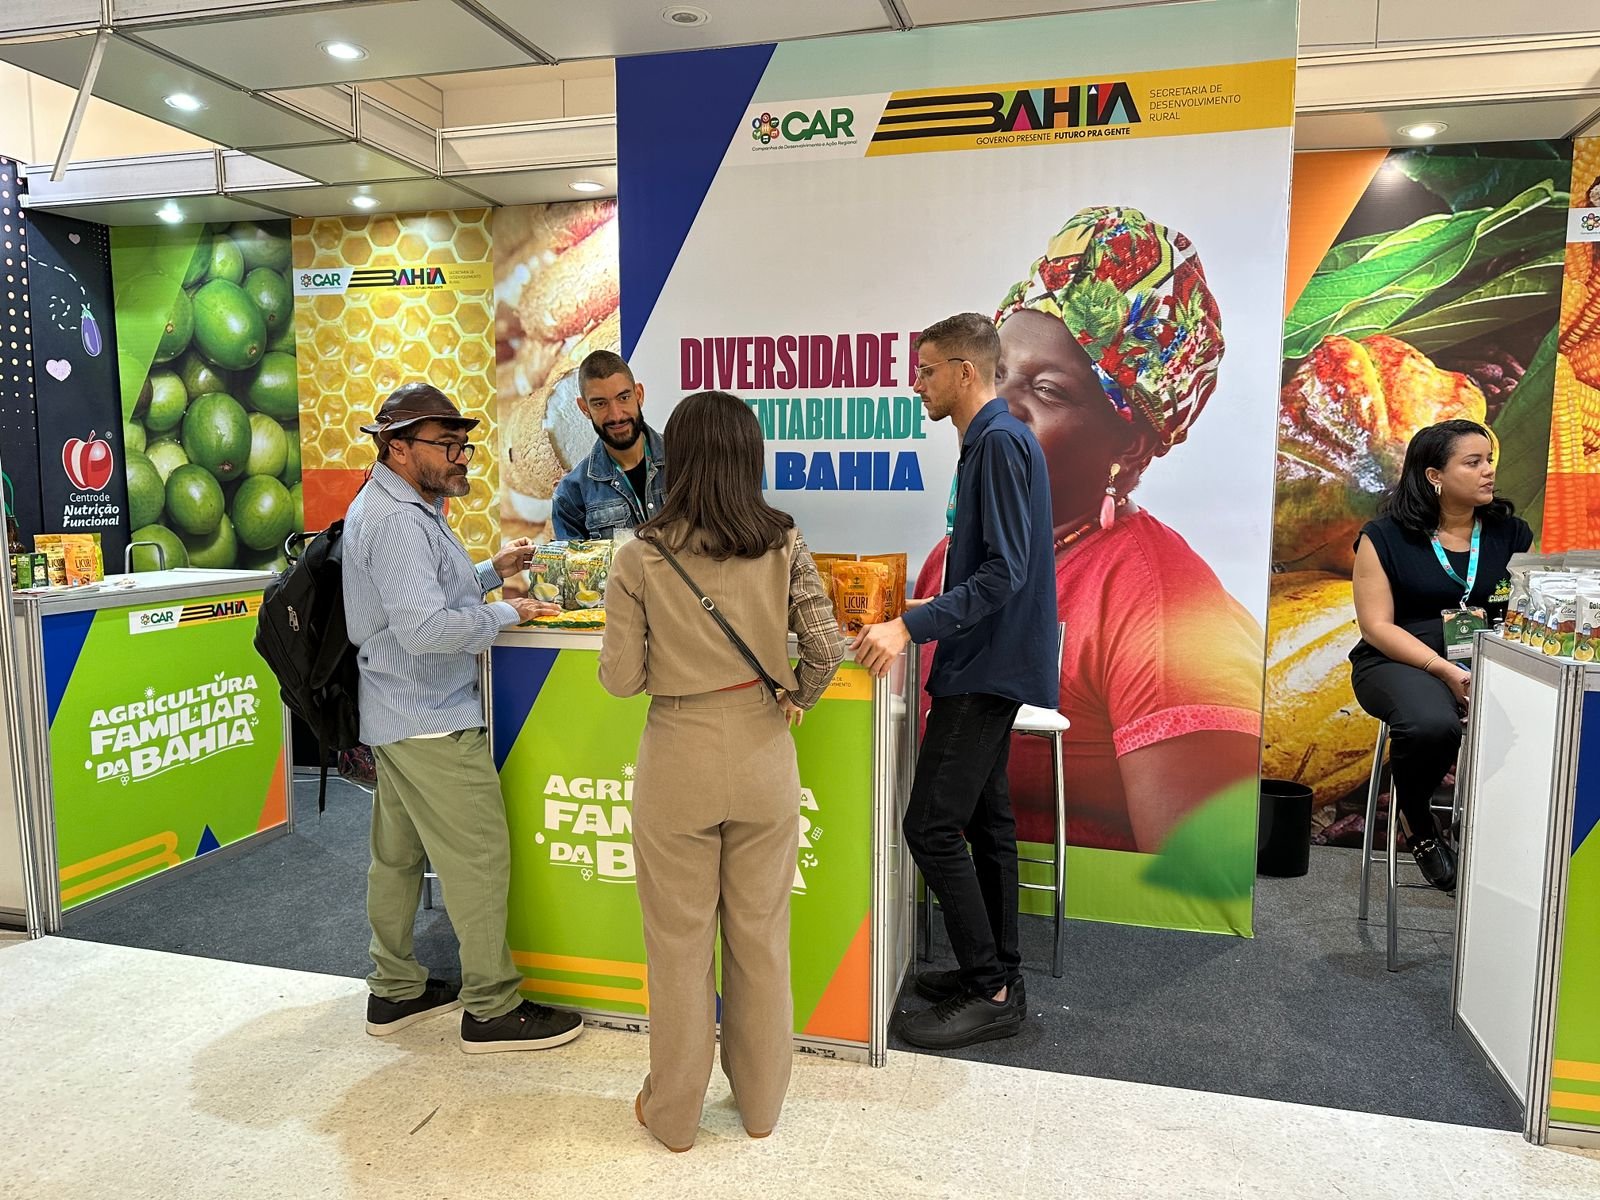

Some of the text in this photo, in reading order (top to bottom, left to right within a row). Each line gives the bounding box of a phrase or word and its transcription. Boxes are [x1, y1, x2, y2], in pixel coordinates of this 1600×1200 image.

[1149, 83, 1223, 99] SECRETARIA DE
[1149, 94, 1241, 110] DESENVOLVIMENTO
[781, 107, 855, 142] CAR
[1149, 112, 1181, 122] RURAL
[976, 127, 1131, 145] GOVERNO PRESENTE FUTURO PRA GENTE
[312, 273, 341, 287] CAR
[680, 332, 899, 391] DIVERSIDADE
[744, 397, 927, 441] NTABILIDADE
[775, 451, 925, 491] BAHIA
[69, 491, 111, 503] Centro de
[63, 503, 120, 518] Nutrição
[62, 515, 120, 528] Funcional
[843, 595, 869, 609] LICURI
[150, 611, 174, 624] CAR
[89, 674, 258, 728] AGRICULTURA
[90, 693, 257, 755] FAMILIAR
[97, 717, 255, 779] DA BAHIA
[550, 842, 594, 864] DA
